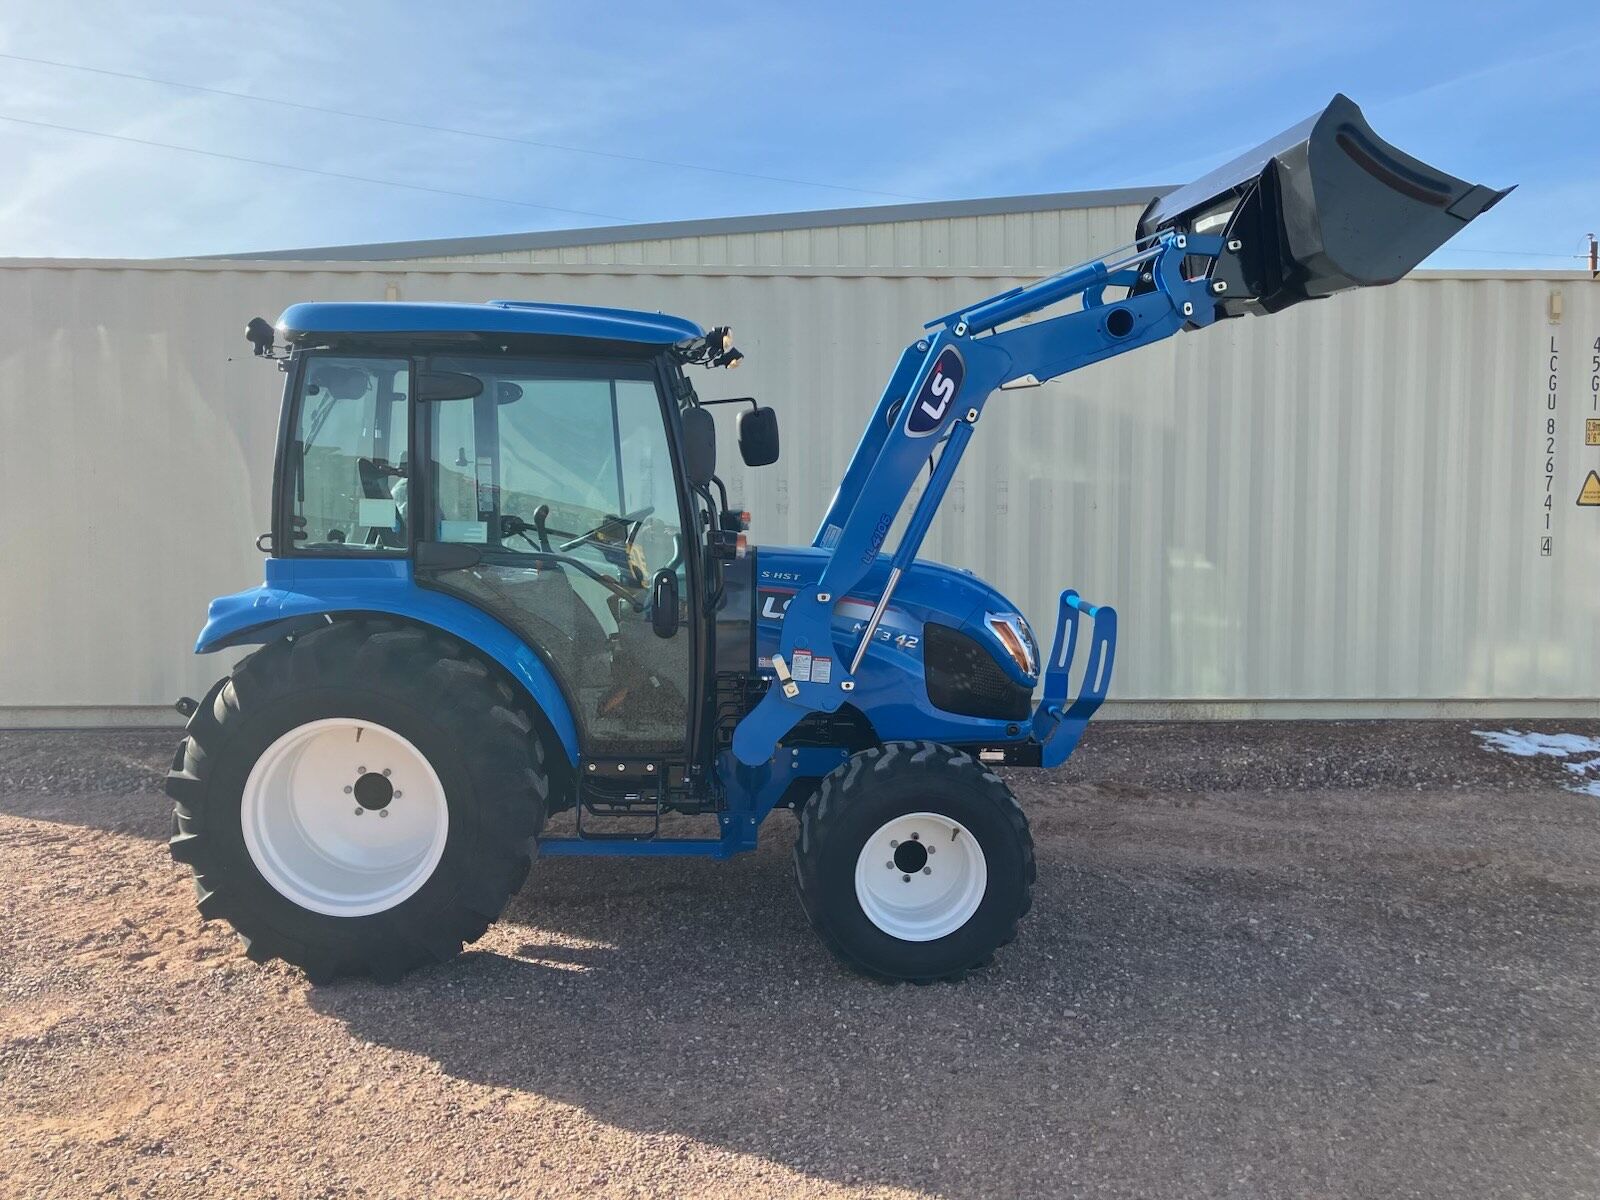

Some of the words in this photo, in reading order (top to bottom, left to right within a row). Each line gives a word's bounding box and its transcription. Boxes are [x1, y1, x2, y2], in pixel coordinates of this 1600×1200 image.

[920, 372, 955, 420] LS
[1548, 336, 1558, 410] LCGU
[1544, 418, 1555, 530] 826741
[1542, 538, 1550, 555] 4
[894, 634, 919, 649] 42
